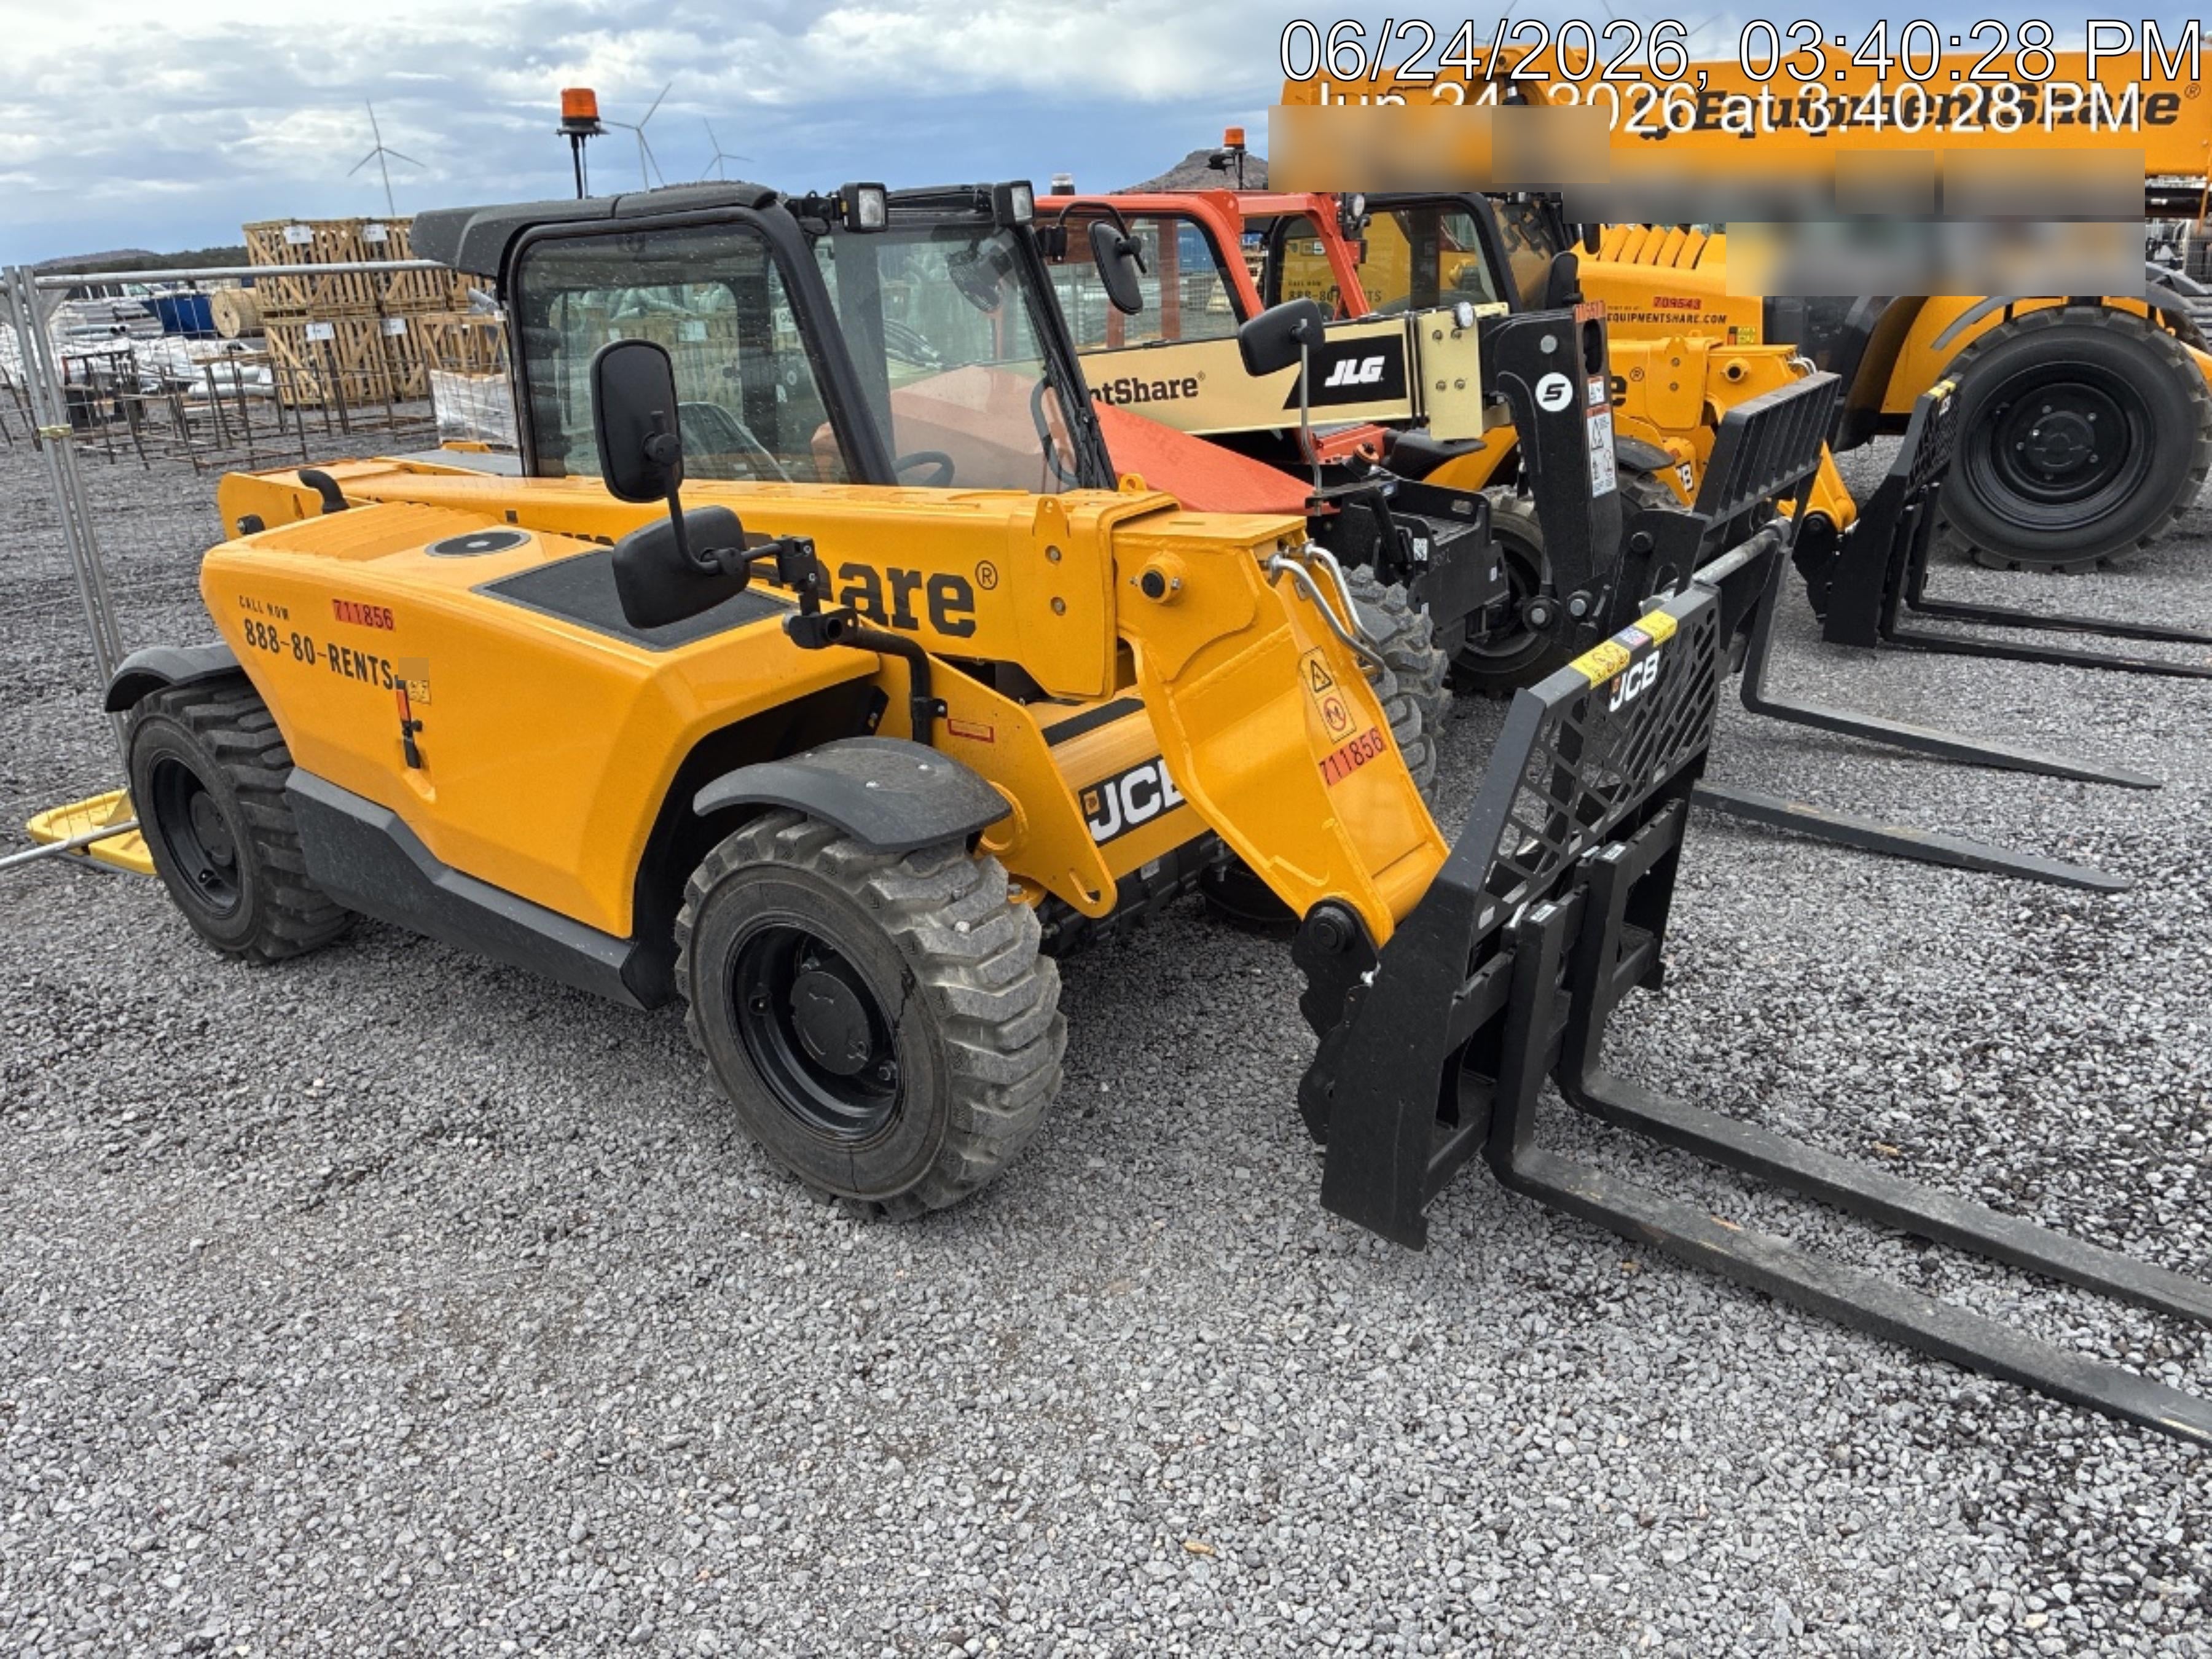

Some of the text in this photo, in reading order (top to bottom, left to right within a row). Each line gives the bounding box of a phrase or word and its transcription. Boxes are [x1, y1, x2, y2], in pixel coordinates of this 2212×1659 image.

[1325, 355, 1385, 387] JLG
[239, 595, 289, 621] CALL NOW
[332, 598, 394, 631] 711856
[245, 618, 394, 690] 888-80-RENTS
[1609, 650, 1660, 712] JCB
[1318, 727, 1384, 786] 711856
